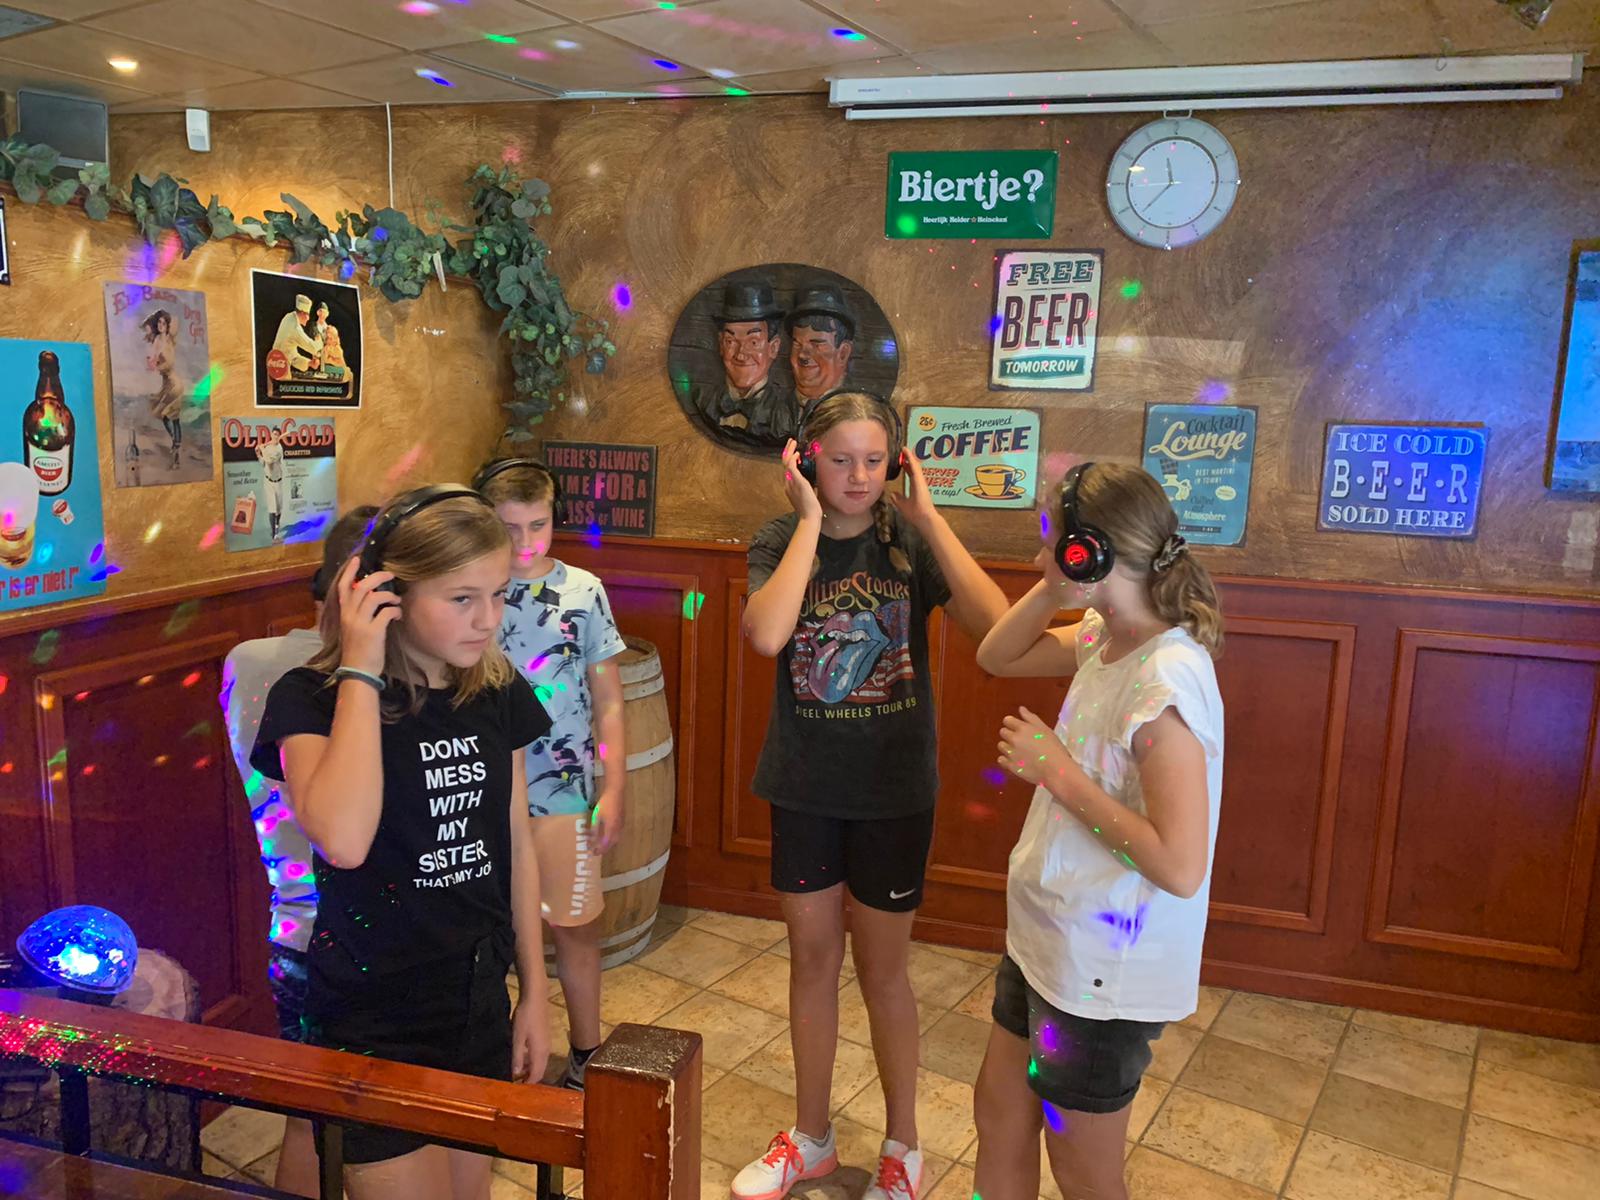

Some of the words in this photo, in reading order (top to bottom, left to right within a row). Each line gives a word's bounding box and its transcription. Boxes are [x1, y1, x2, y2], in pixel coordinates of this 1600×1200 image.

[898, 169, 1044, 210] Biertje?
[1007, 260, 1095, 285] FREE
[1001, 293, 1090, 350] BEER
[1006, 359, 1078, 374] TOMORROW
[223, 418, 272, 448] OLD
[281, 418, 334, 447] GOLD
[941, 420, 970, 432] Fresh
[974, 416, 1012, 429] Brewed
[1187, 414, 1245, 434] Cocktail
[914, 426, 1032, 460] COFFEE
[1148, 421, 1247, 461] Lounge
[1336, 432, 1388, 453] ICE
[1394, 434, 1474, 456] COLD
[547, 447, 597, 469] THERE'S
[599, 450, 650, 472] ALWAYS
[559, 474, 590, 495] IME
[595, 471, 634, 500] FOR
[636, 479, 647, 498] A
[612, 507, 645, 528] WINE
[1328, 505, 1389, 525] SOLD
[1395, 508, 1466, 528] HERE
[801, 577, 856, 617] olling
[825, 707, 871, 719] WHEELS
[876, 701, 903, 715] TOUR
[419, 736, 480, 761] DONT
[425, 761, 486, 790] MESS
[429, 789, 483, 817] WITH
[436, 817, 468, 841] MY
[419, 839, 488, 873] SISTER
[454, 868, 473, 884] MY
